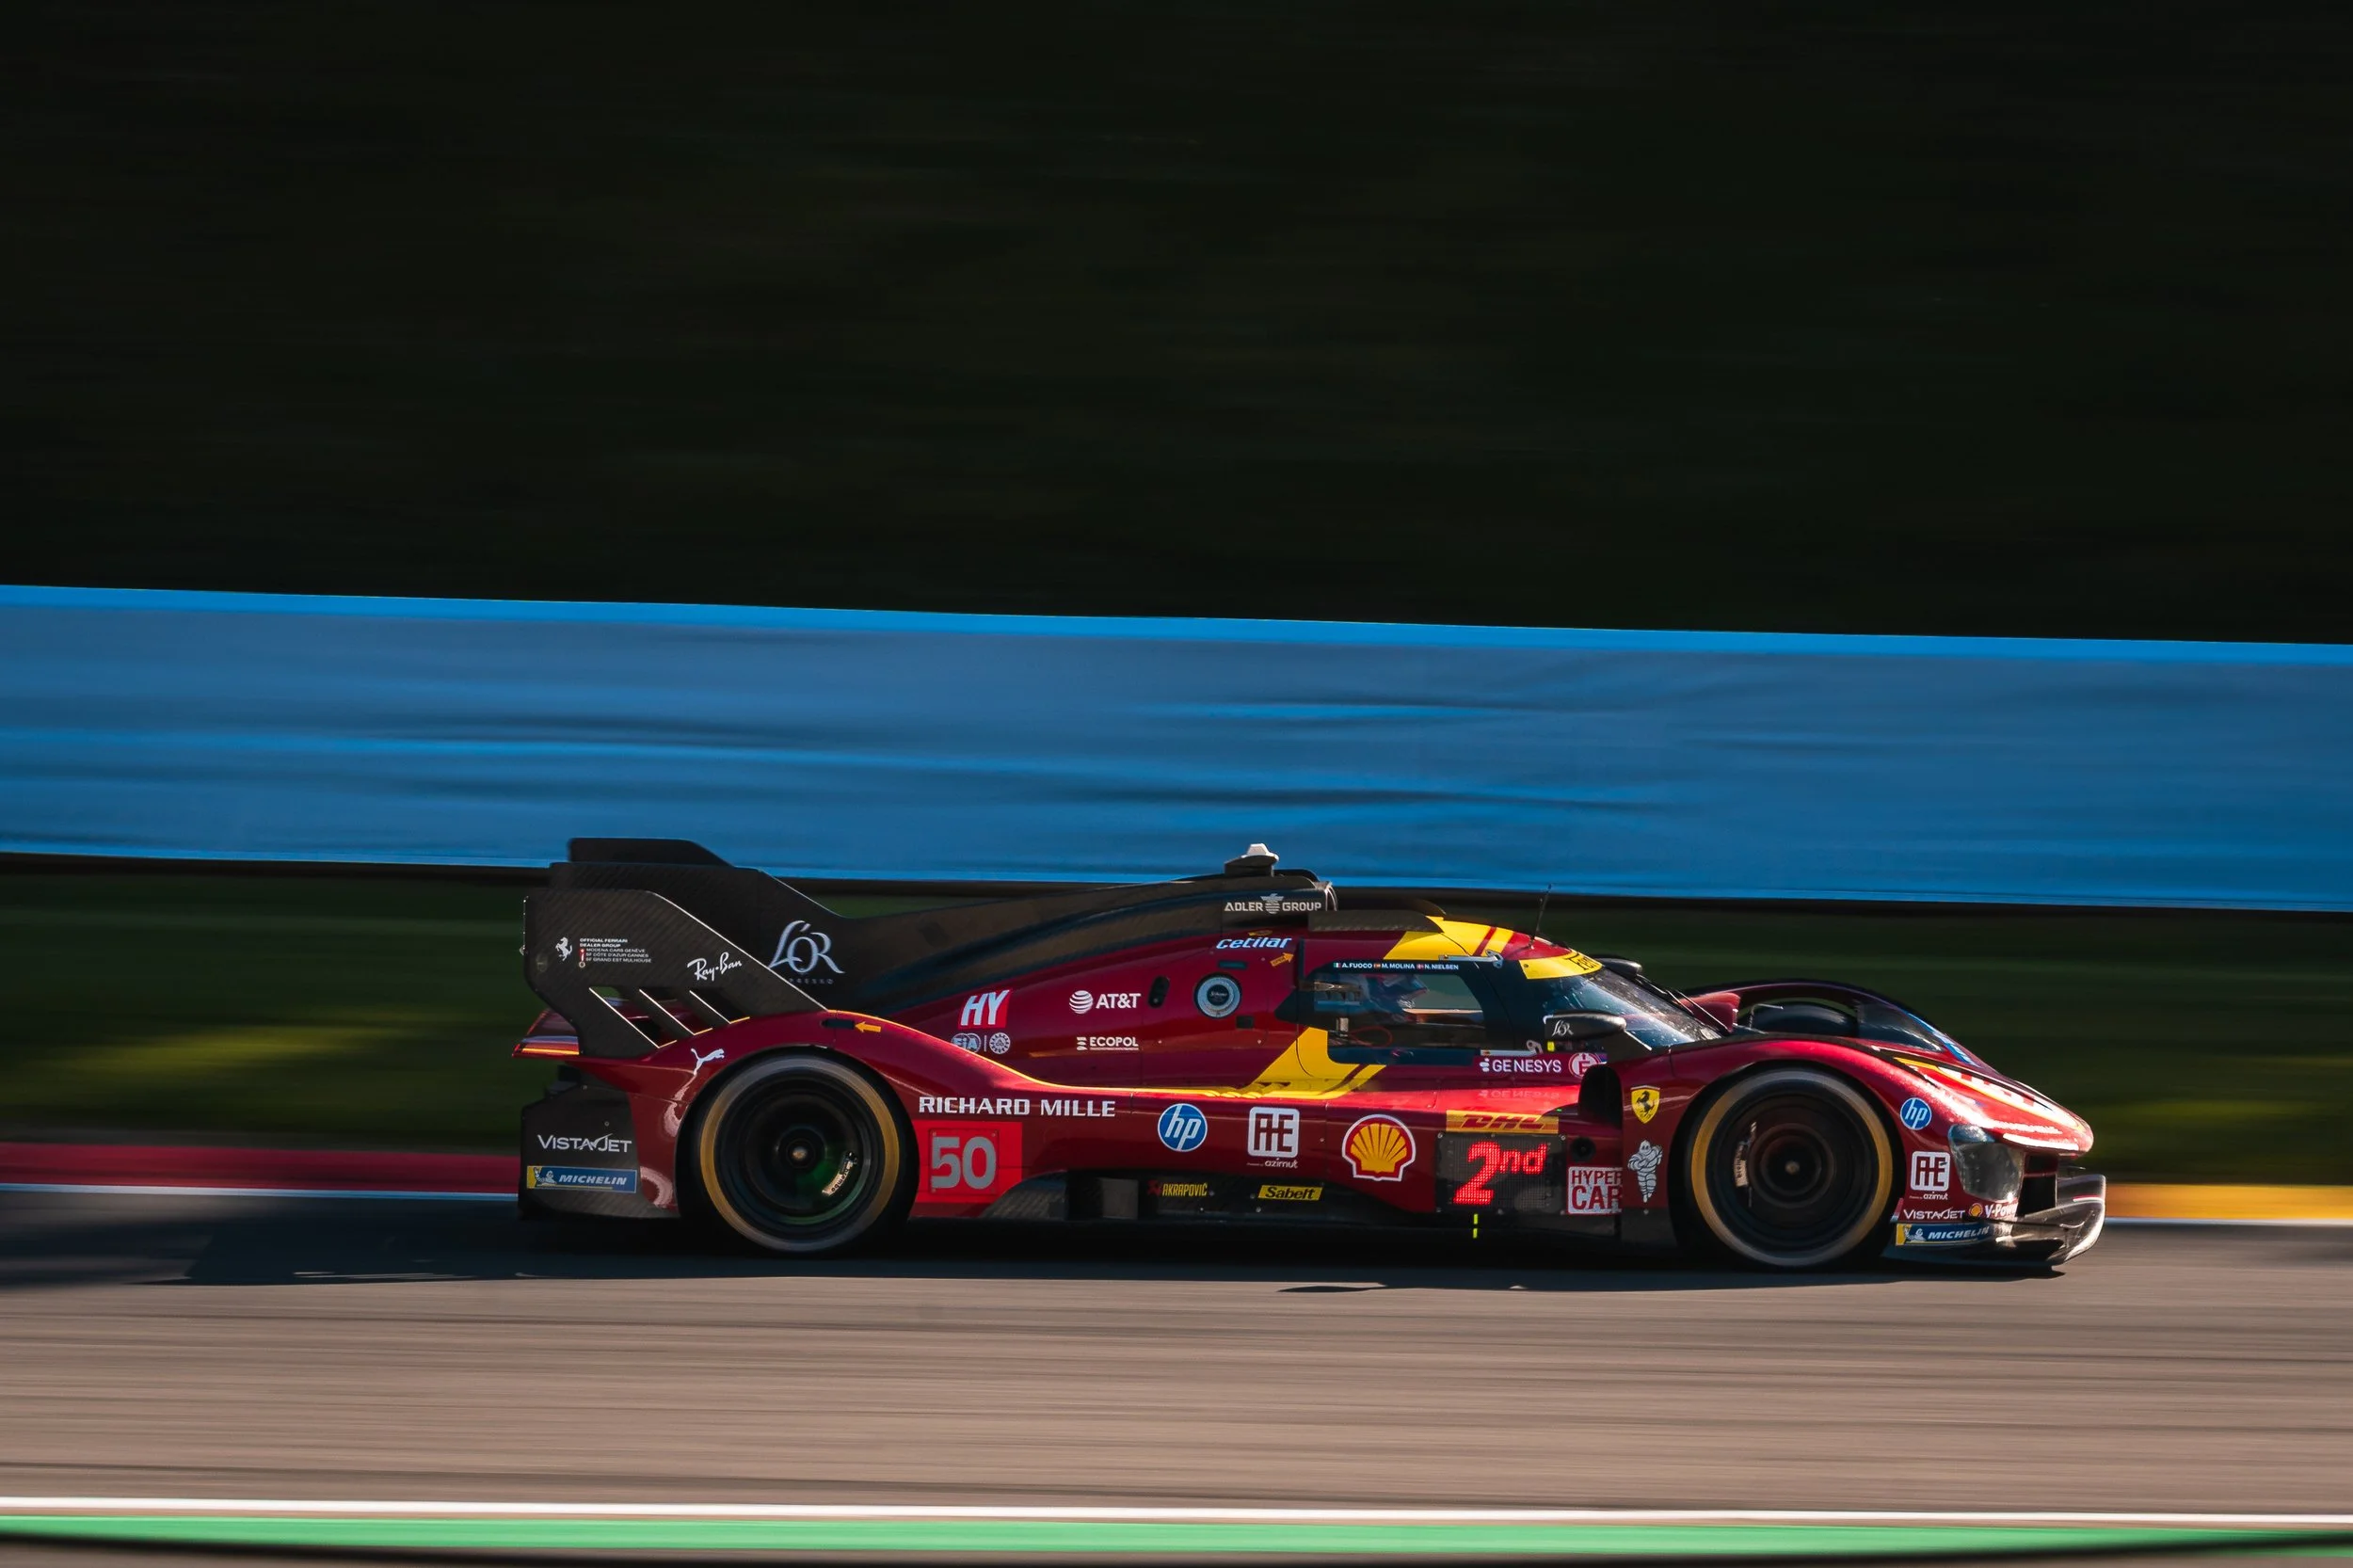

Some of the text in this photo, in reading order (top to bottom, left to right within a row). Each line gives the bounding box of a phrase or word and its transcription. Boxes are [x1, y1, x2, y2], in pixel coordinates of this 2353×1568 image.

[1224, 902, 1321, 912] ADLER GROUP
[960, 989, 1010, 1026] HY
[1096, 993, 1142, 1009] AT&T
[1089, 1036, 1139, 1047] ECOPOL
[1492, 1059, 1562, 1073] GENESYS
[919, 1096, 1116, 1117] RICHARD MILLE
[1904, 1098, 1928, 1128] hp
[1164, 1104, 1202, 1151] hp
[1460, 1113, 1545, 1130] DHL
[931, 1136, 997, 1190] 50
[1264, 1158, 1298, 1168] azimut
[559, 1175, 627, 1186] MICHELIN
[1453, 1141, 1547, 1206] 2nd
[1265, 1187, 1316, 1199] Sabelt
[1572, 1186, 1623, 1209] CAR
[1923, 1191, 1948, 1200] azimut
[1928, 1226, 1990, 1240] MICHELIN
